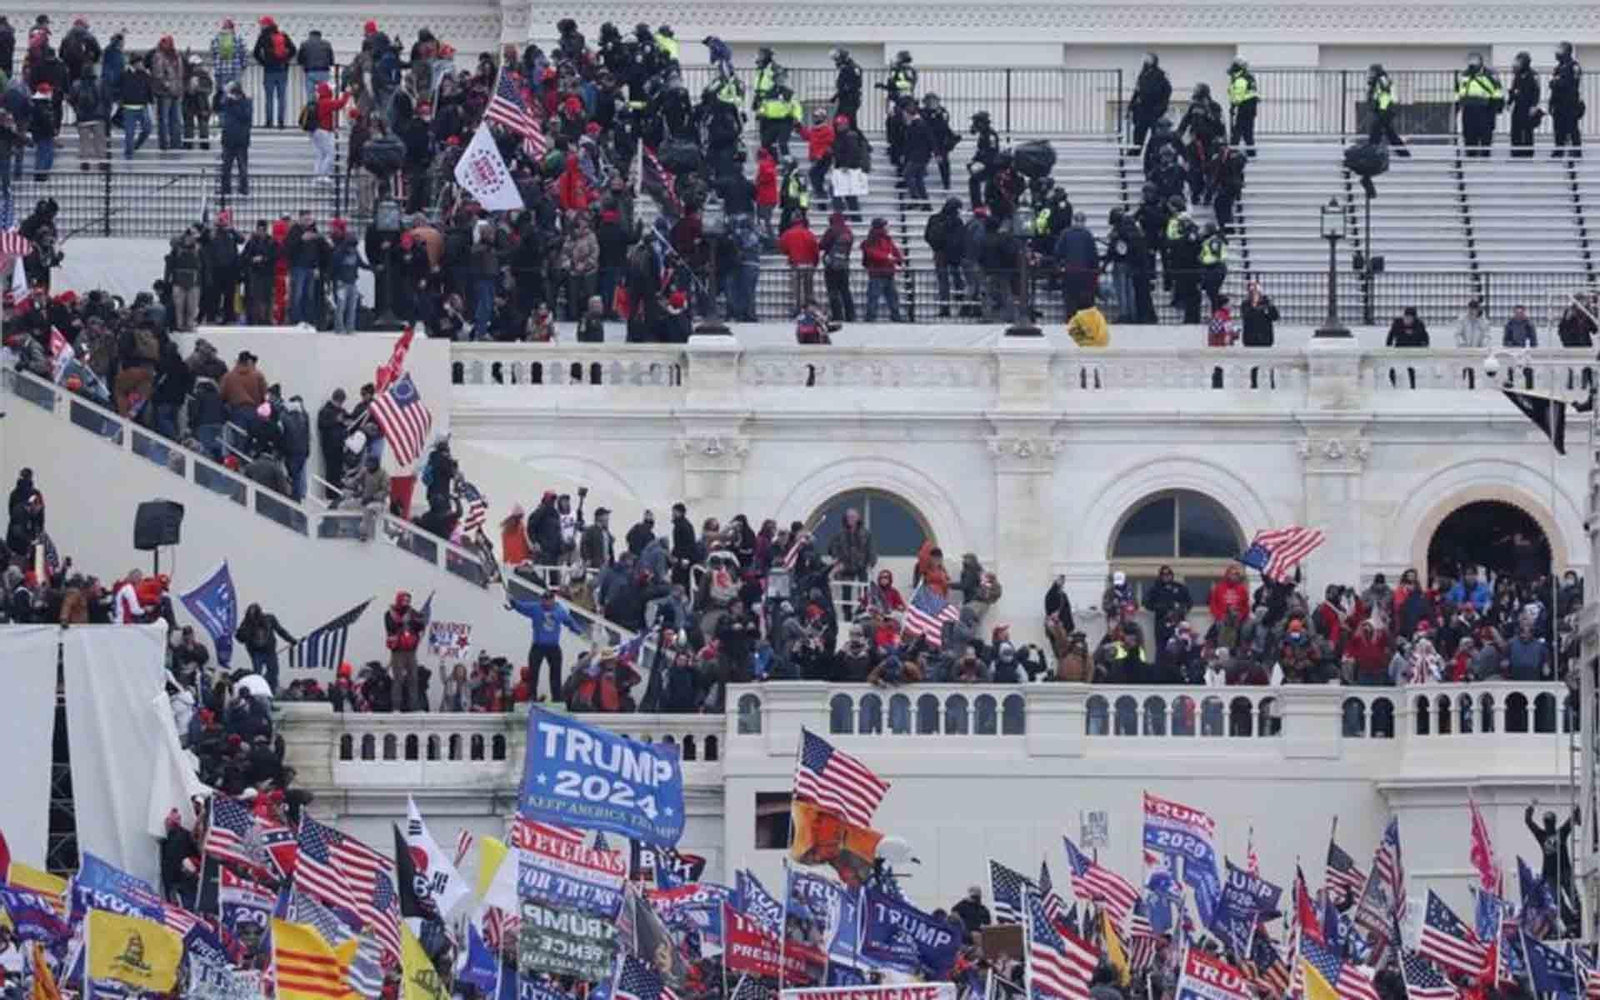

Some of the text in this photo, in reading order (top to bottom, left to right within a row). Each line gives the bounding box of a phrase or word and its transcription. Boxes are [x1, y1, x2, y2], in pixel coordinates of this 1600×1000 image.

[537, 721, 673, 788] TRUMP
[527, 795, 566, 812] KEEP
[571, 799, 627, 822] AMERICA
[552, 770, 659, 820] 2024
[521, 825, 627, 872] VETERANS
[1156, 830, 1207, 859] 2020
[873, 903, 953, 949] TRUMP
